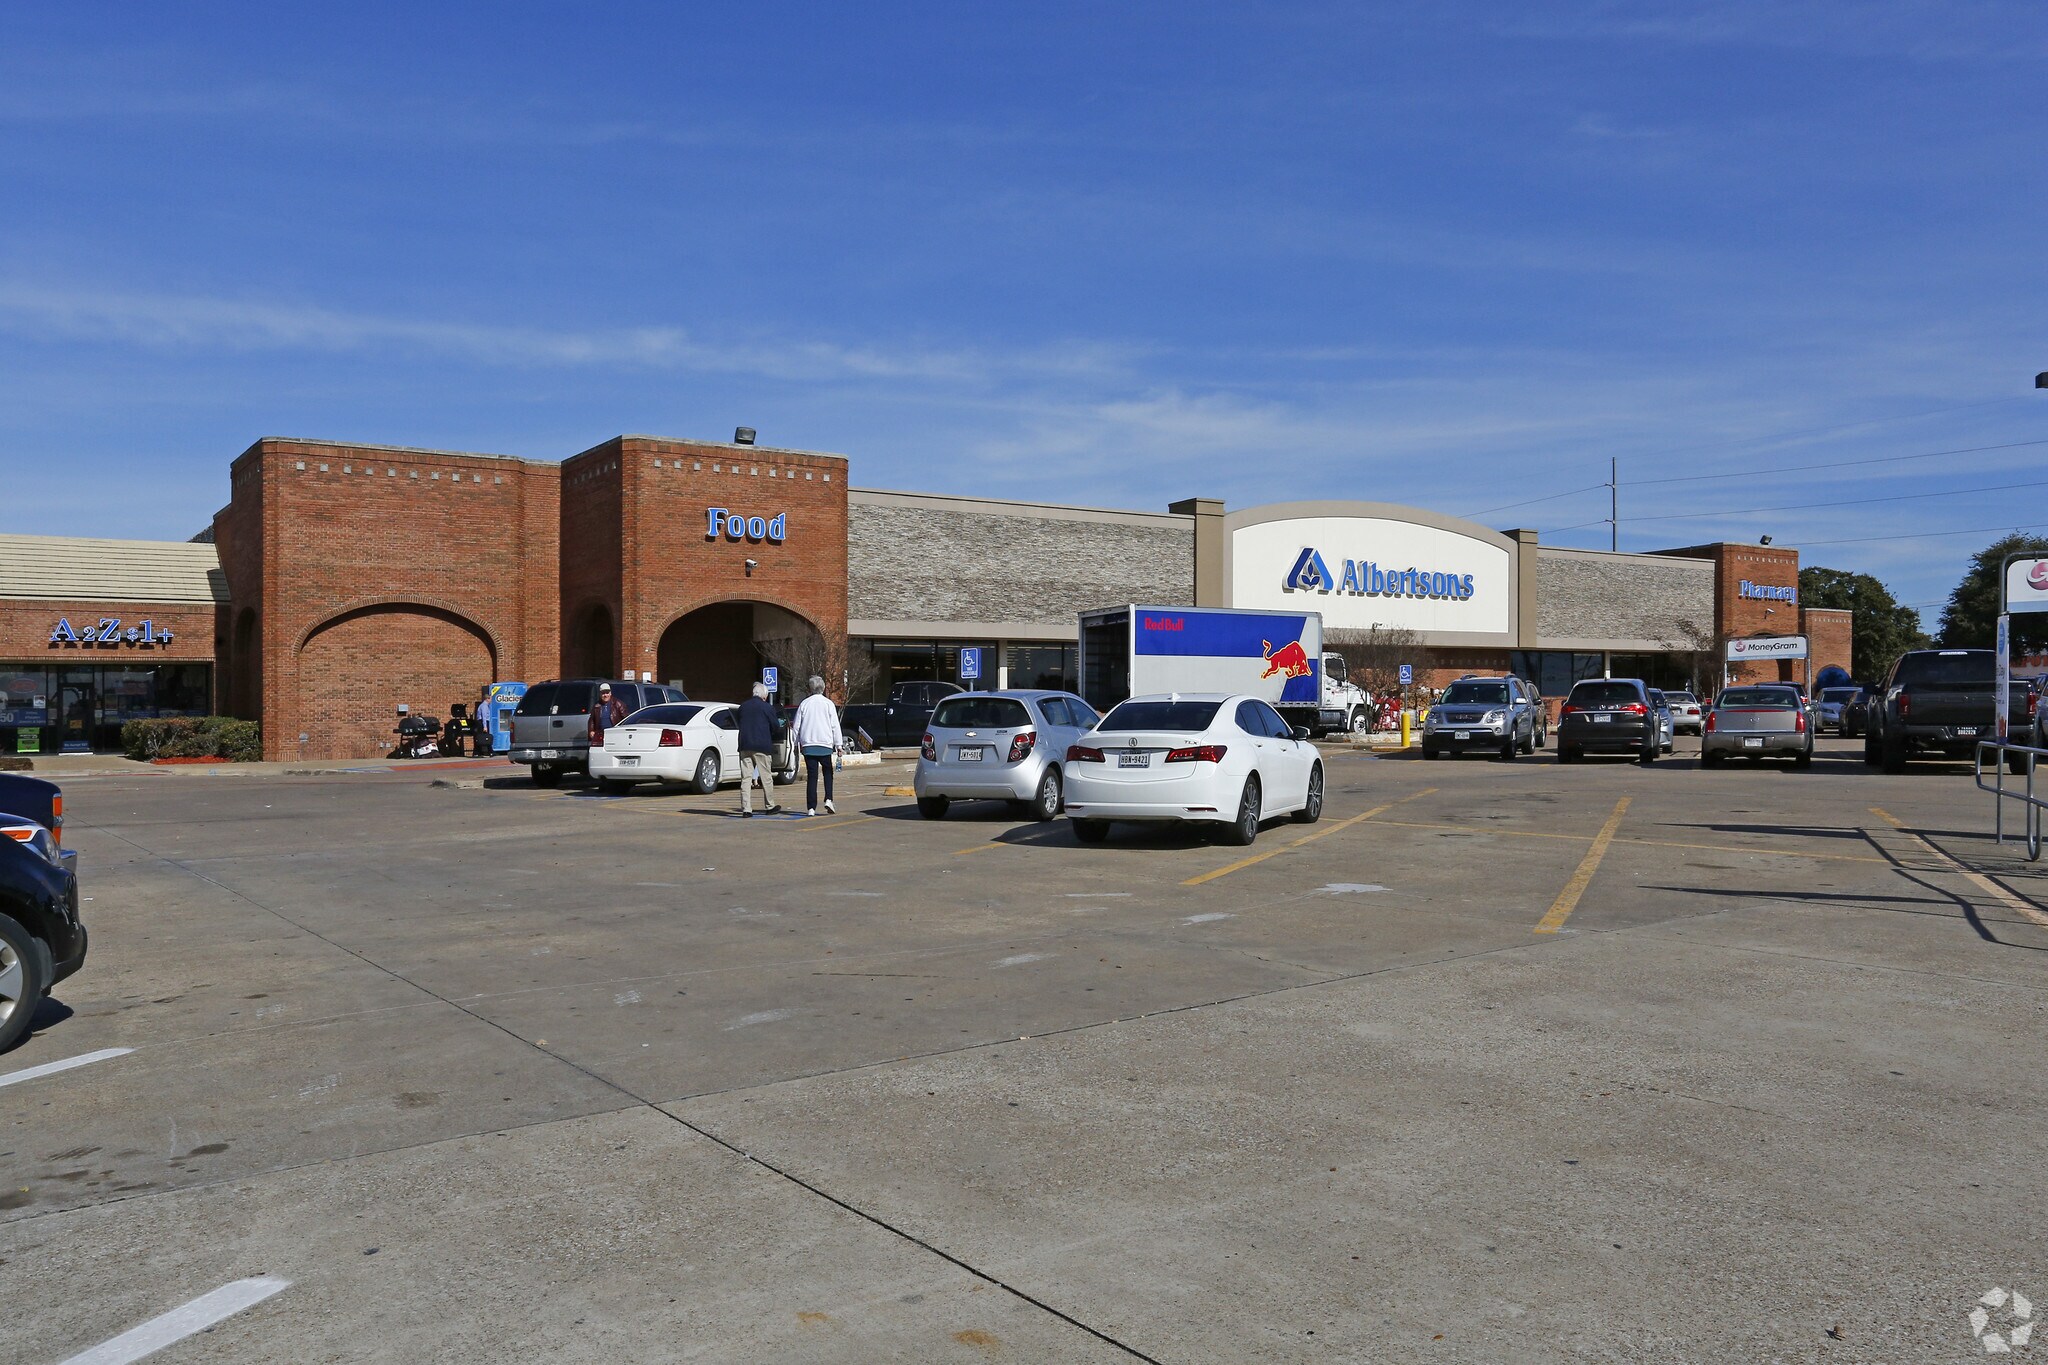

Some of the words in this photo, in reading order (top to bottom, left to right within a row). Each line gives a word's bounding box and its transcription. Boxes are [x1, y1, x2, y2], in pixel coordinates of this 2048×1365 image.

[706, 507, 787, 541] Food
[1339, 559, 1475, 597] Albertsons
[1738, 579, 1797, 604] Pharmacy
[50, 617, 121, 643] A2Z
[1144, 617, 1165, 631] Red
[1165, 618, 1184, 631] Bull
[1748, 642, 1798, 652] MoneyGram
